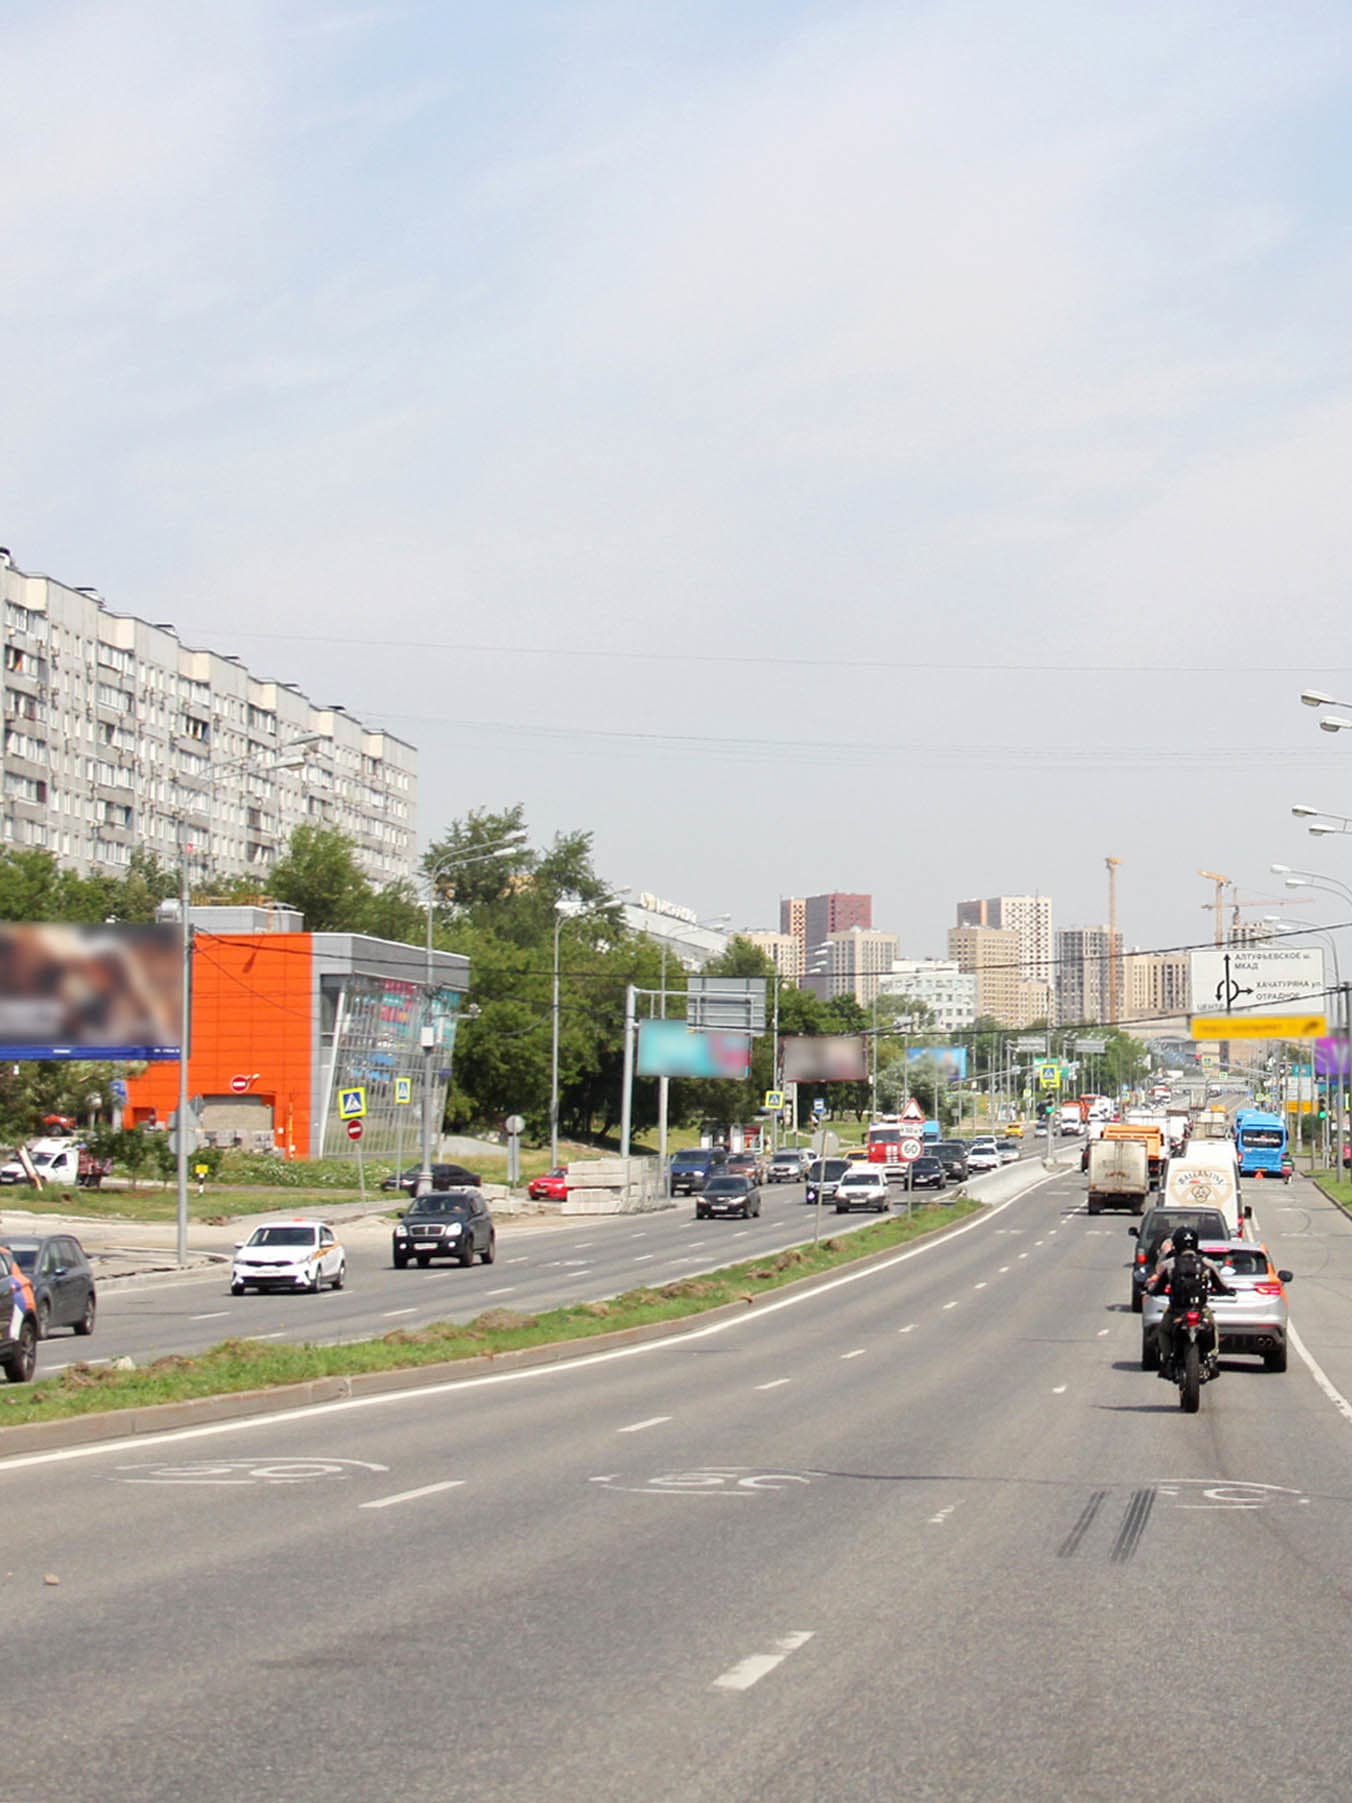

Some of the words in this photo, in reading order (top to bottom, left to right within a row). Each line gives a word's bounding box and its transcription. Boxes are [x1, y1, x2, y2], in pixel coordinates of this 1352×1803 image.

[1235, 952, 1301, 961] АЛТУФЬЕВСКОЕ
[1234, 962, 1259, 970] МКАД
[903, 1143, 919, 1155] 60
